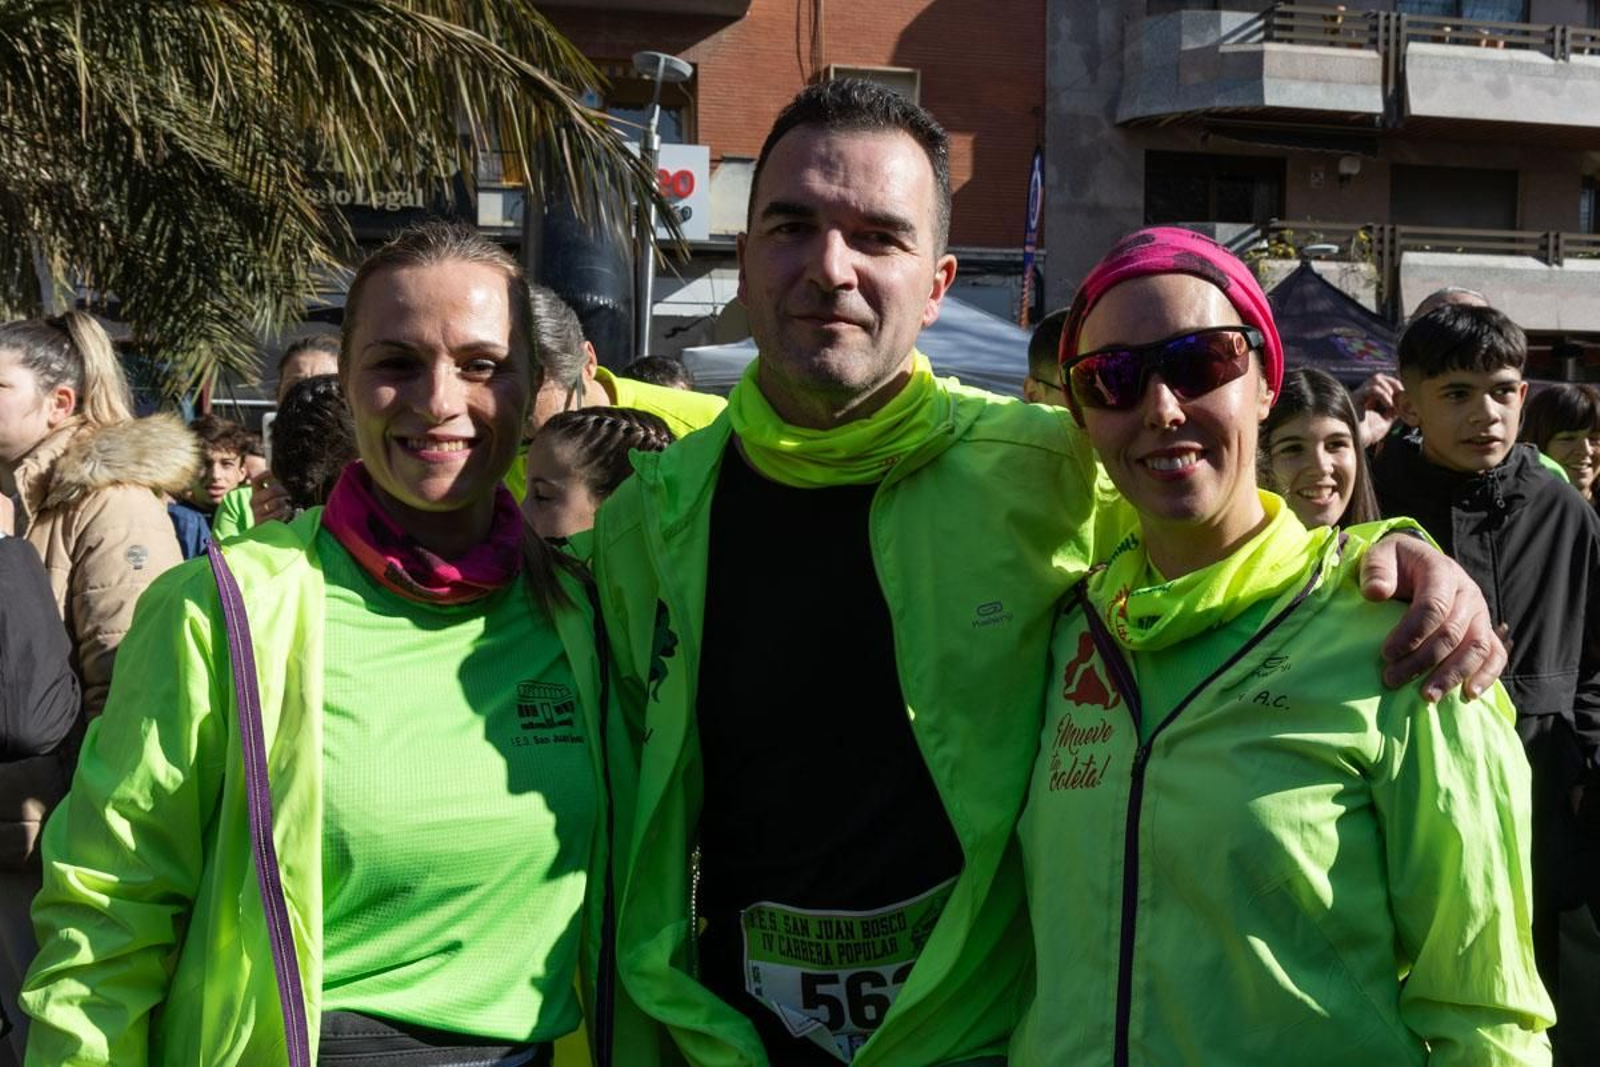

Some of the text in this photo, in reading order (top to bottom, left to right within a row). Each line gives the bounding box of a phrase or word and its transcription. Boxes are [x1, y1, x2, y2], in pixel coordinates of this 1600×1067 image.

[354, 183, 425, 212] Legal
[1253, 691, 1290, 710] A.C.
[532, 735, 551, 745] San
[1050, 754, 1111, 791] coleta!
[784, 915, 810, 939] SAN
[817, 920, 854, 940] JUAN
[861, 912, 906, 937] BOSCO
[762, 932, 898, 965] IV CARRERA POPULAR
